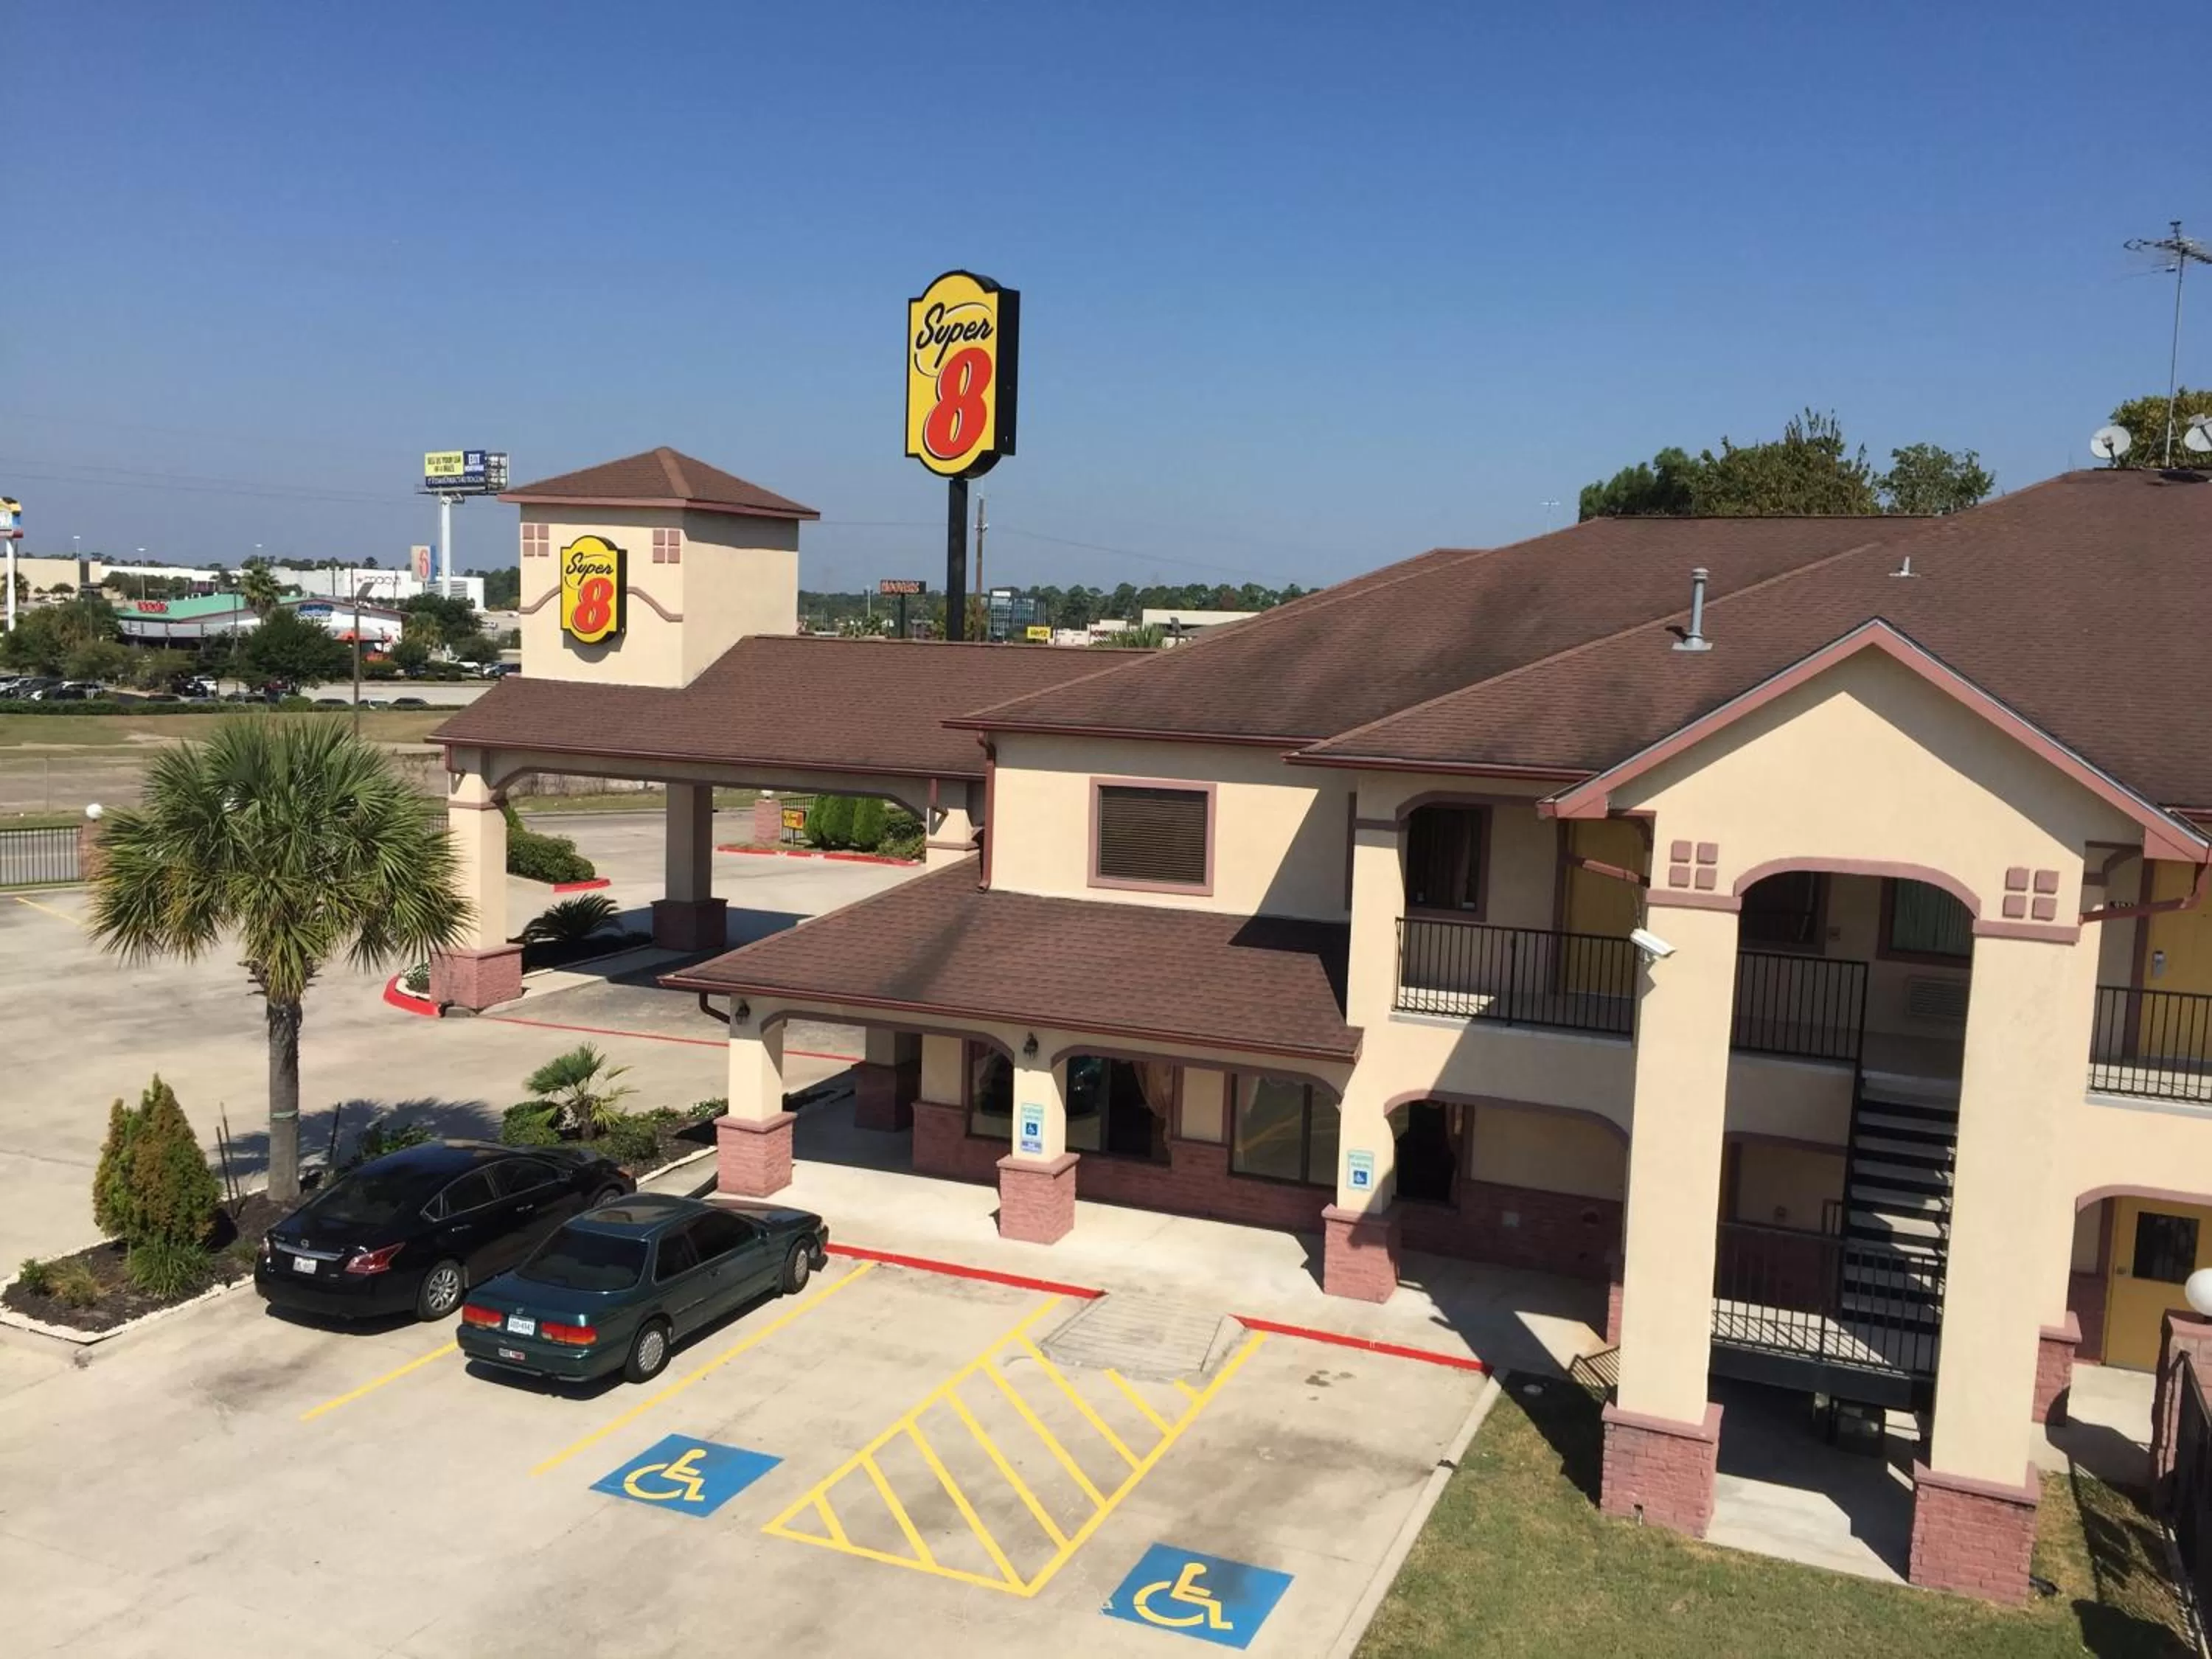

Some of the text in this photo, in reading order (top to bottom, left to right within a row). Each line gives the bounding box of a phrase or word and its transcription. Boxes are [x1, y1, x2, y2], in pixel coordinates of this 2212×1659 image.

[916, 302, 993, 368] Super
[923, 347, 992, 460] 8
[566, 552, 613, 586] Super
[570, 577, 614, 634] 8
